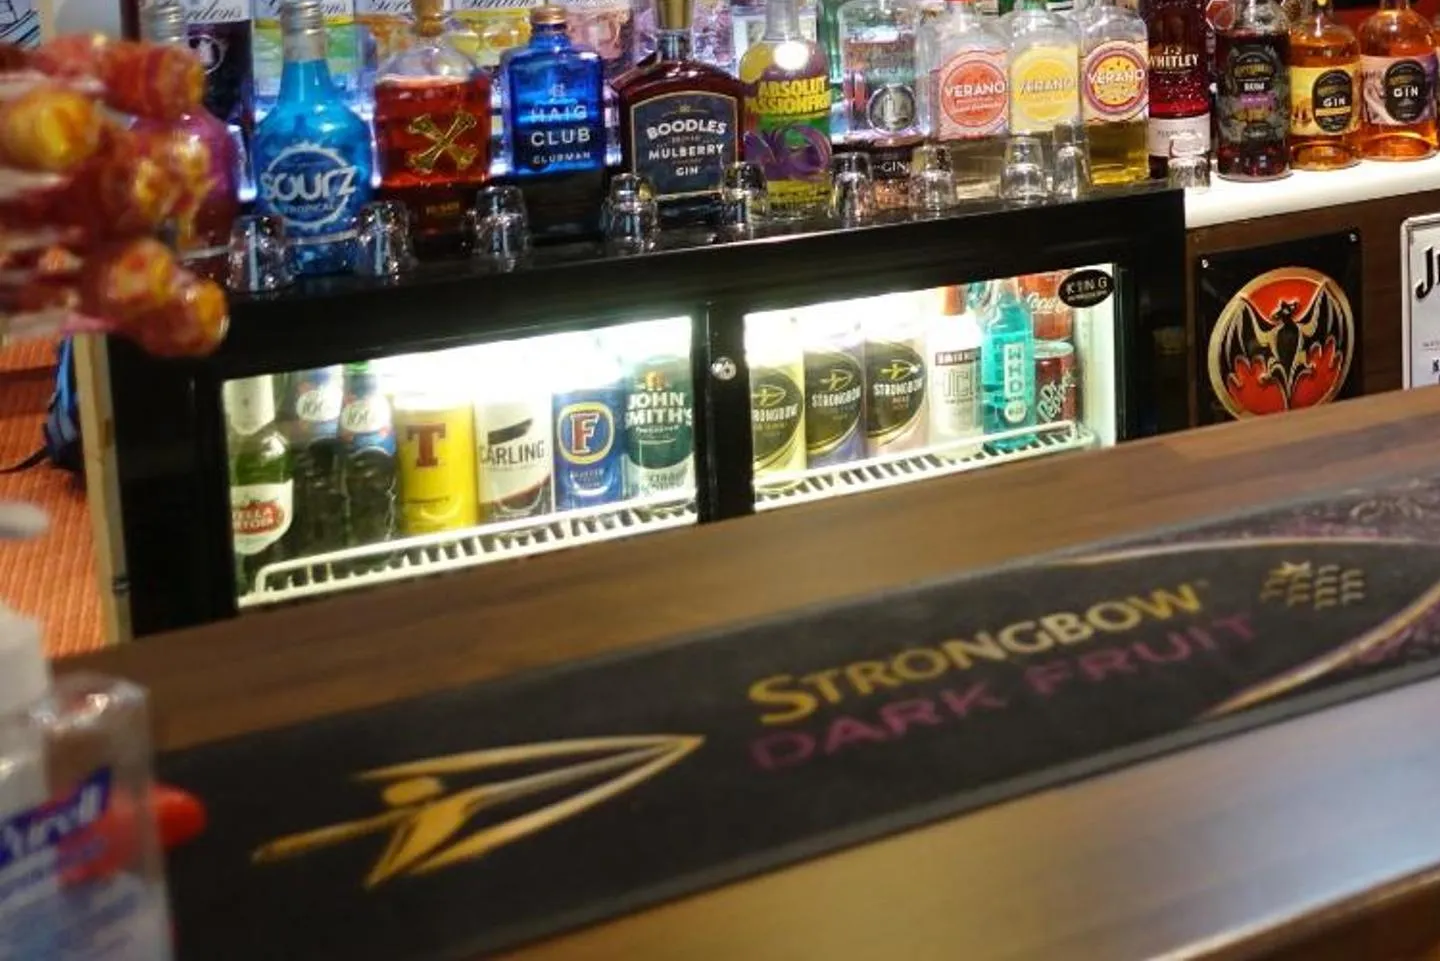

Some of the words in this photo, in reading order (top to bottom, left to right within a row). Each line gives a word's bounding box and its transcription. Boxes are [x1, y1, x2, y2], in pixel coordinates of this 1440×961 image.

[757, 75, 828, 97] ABSOLUT
[1017, 76, 1077, 96] VERANO
[1086, 67, 1146, 86] VERANO
[945, 80, 1006, 98] VERANO
[1392, 85, 1420, 99] GIN
[1321, 96, 1347, 108] GIN
[530, 103, 588, 124] HAIG
[530, 128, 591, 148] CLUB
[646, 118, 728, 140] BOODLES
[532, 151, 592, 165] CLUBMAN
[648, 142, 725, 161] MULBERRY
[675, 165, 699, 178] GIN
[880, 159, 908, 173] GIN
[1065, 276, 1109, 294] KING
[811, 385, 862, 409] STRONGBOW
[872, 378, 924, 399] STRONGBOW
[628, 392, 685, 410] JOHN
[624, 406, 693, 427] SMITH'S
[570, 410, 600, 457] F
[407, 422, 447, 468] T
[479, 440, 545, 466] CARLING
[749, 581, 1203, 725] STRONGBOW
[750, 680, 1007, 772] DARK
[1024, 612, 1258, 698] FRUIT
